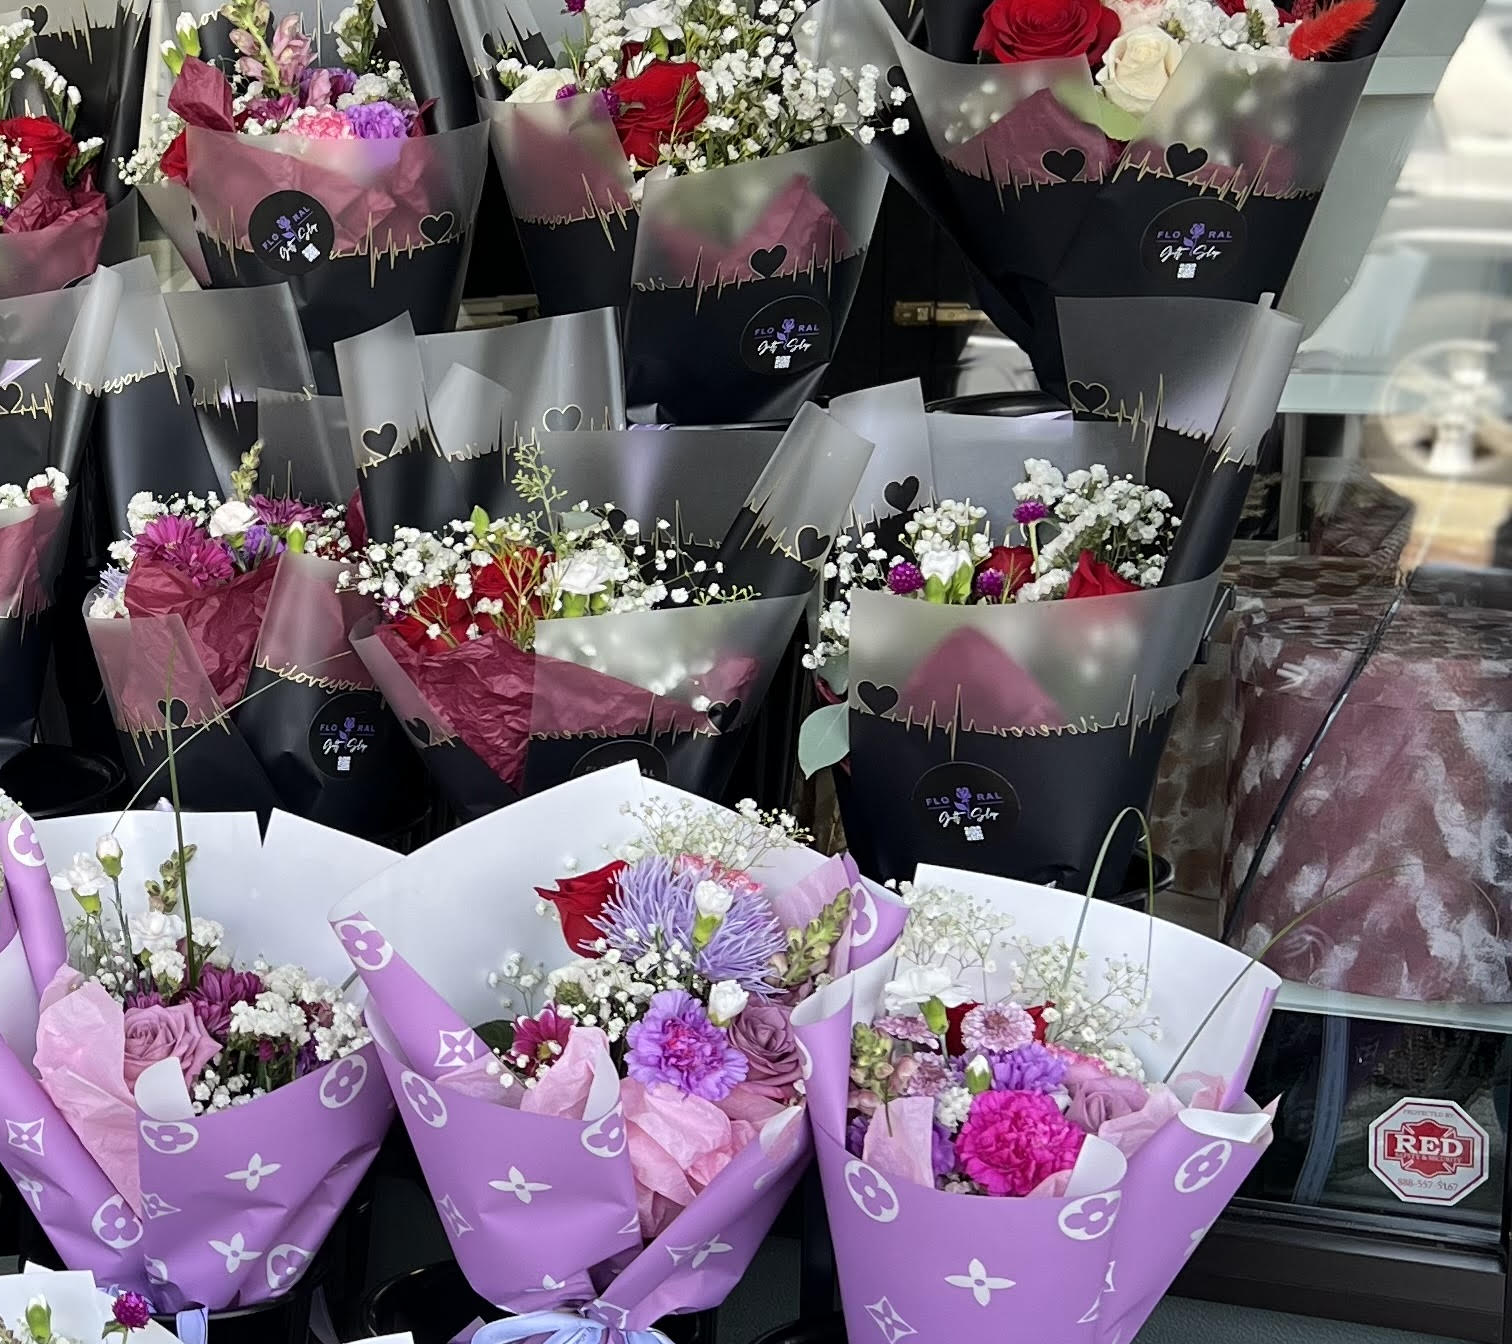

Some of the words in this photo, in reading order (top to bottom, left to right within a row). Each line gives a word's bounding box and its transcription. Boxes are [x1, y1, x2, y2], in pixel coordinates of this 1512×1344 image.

[262, 233, 279, 250] FLO
[292, 206, 310, 222] RAL
[1157, 231, 1181, 239] FLO
[754, 327, 774, 335] FLO
[798, 324, 819, 332] RAL
[357, 724, 375, 732] RAL
[925, 796, 950, 807] FLO
[976, 792, 1003, 801] RAL
[1394, 1134, 1463, 1157] RED
